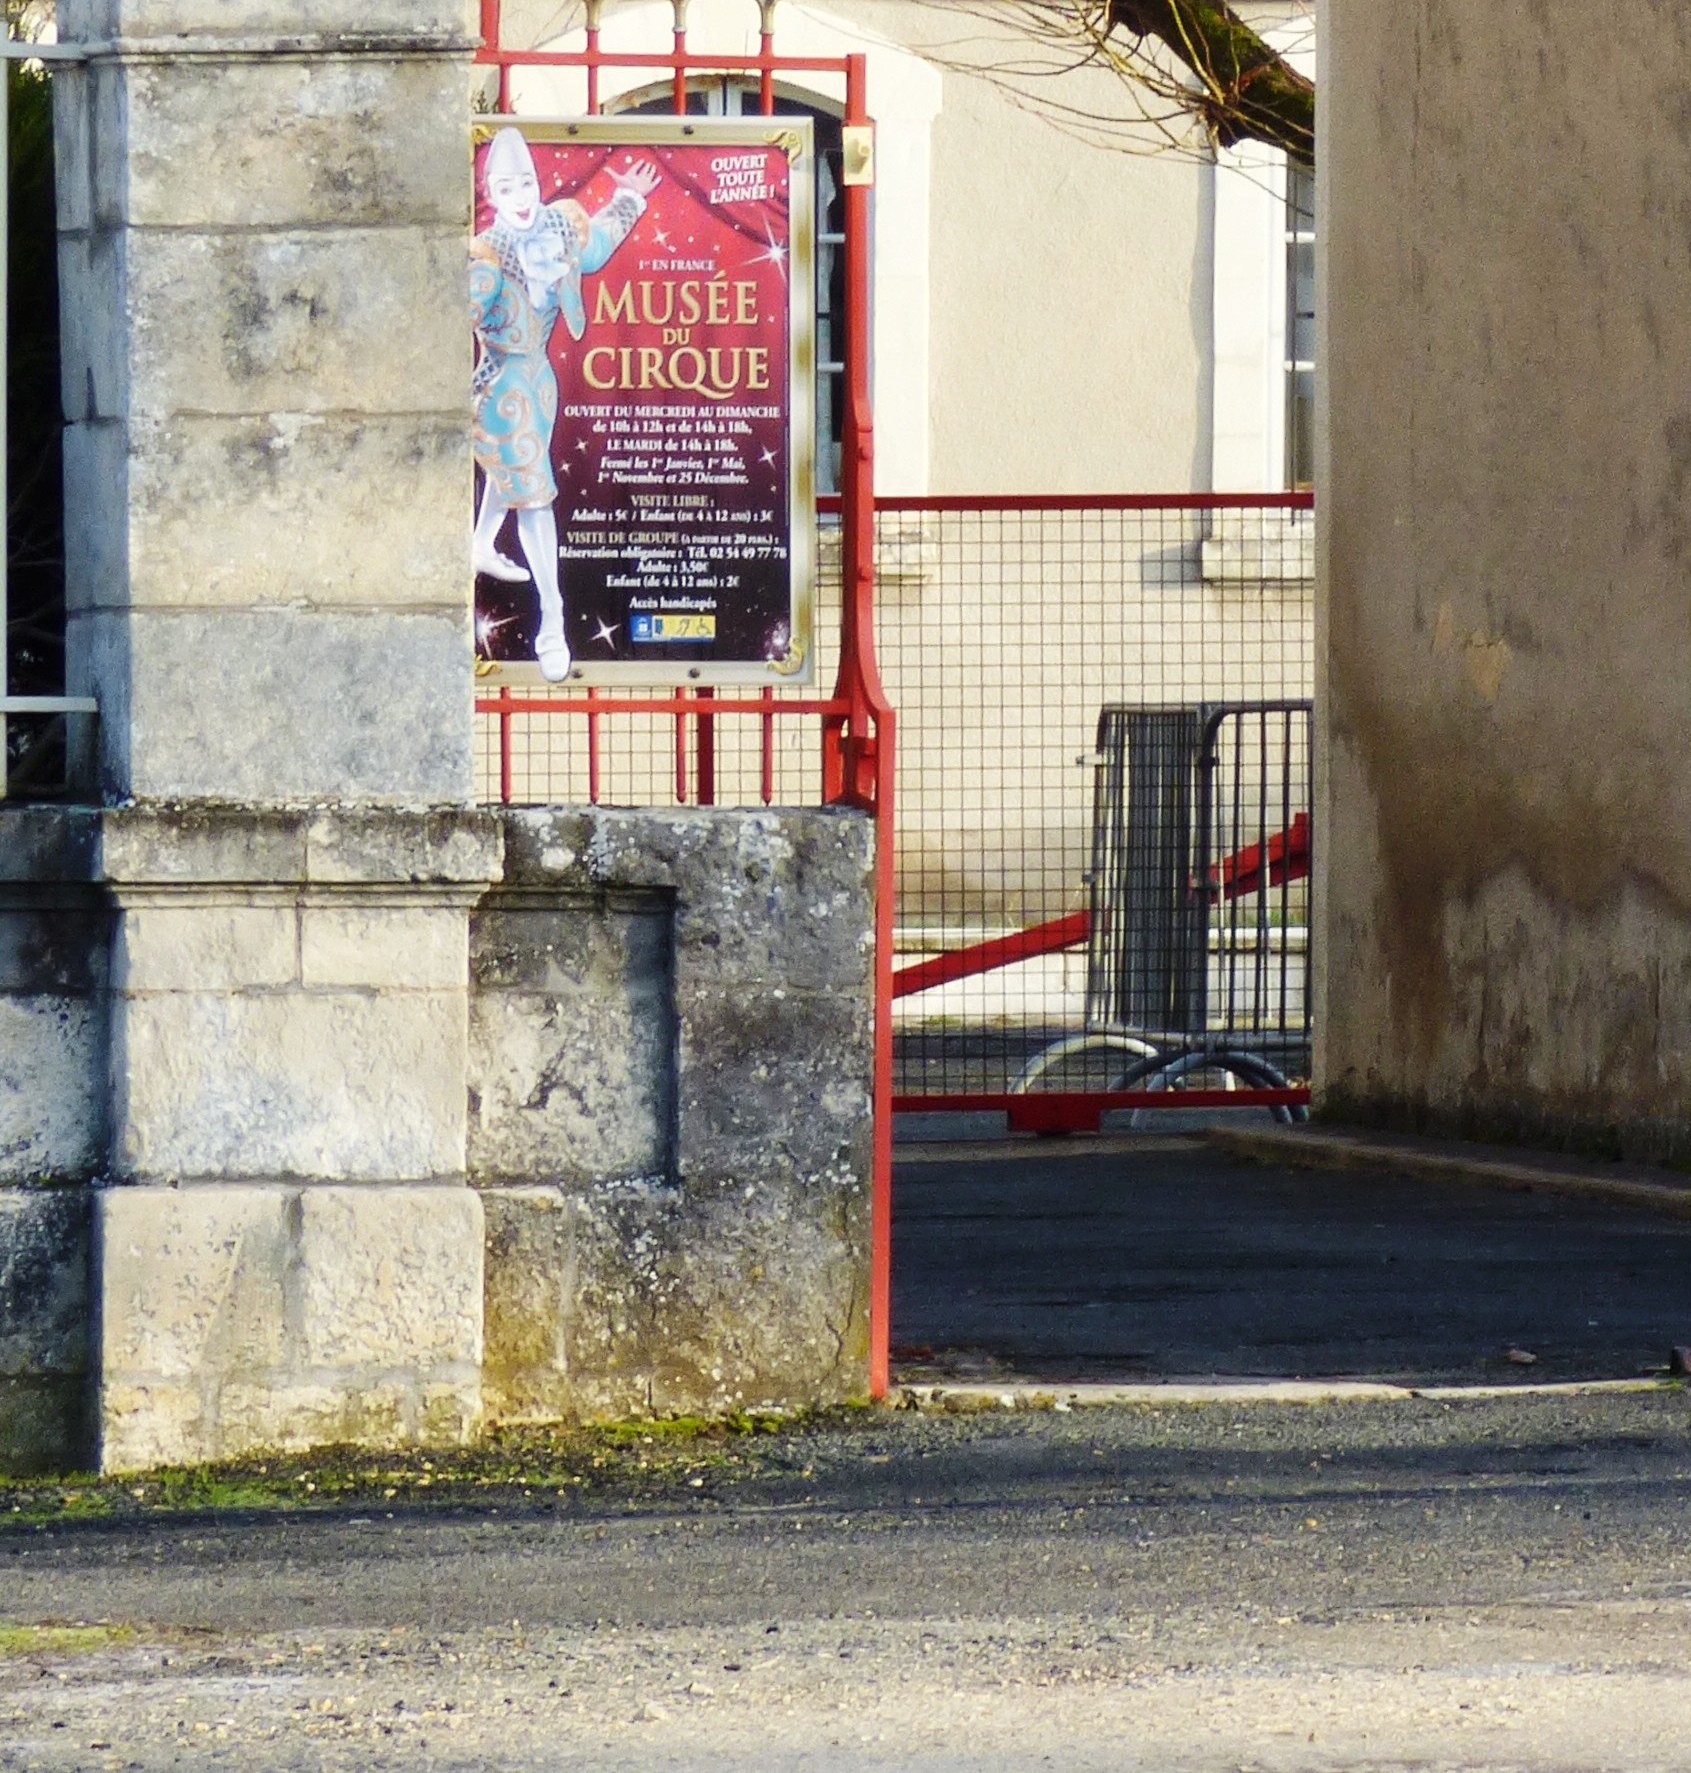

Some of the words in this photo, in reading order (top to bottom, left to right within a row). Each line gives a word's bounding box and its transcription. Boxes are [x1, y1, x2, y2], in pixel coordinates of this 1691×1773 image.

[711, 153, 768, 172] OUVERT
[717, 170, 764, 187] TOUTE
[652, 259, 669, 270] EN
[671, 259, 715, 271] FRANCE
[592, 270, 758, 325] MUSÉE
[662, 328, 690, 345] DU
[583, 347, 770, 400] CIRQUE
[564, 406, 612, 417] OUVERT
[614, 406, 633, 417] DU
[634, 406, 695, 417] MERCREDI
[698, 406, 714, 417] AU
[716, 406, 780, 417] DIMANCHE
[592, 419, 607, 433] de
[632, 419, 640, 433] à
[643, 419, 663, 433] 12h
[665, 419, 676, 433] et
[678, 419, 692, 433] de
[695, 419, 716, 433] 14h
[607, 438, 621, 451] LE
[623, 438, 662, 451] MARDI
[664, 438, 678, 451] de
[681, 438, 702, 451] 14h
[703, 438, 711, 451] à
[612, 471, 665, 484] Novembre
[666, 471, 677, 484] et
[678, 471, 693, 484] 25
[630, 494, 671, 506] VISITE
[672, 494, 709, 506] LIBRE
[571, 508, 607, 521] Adulte
[640, 508, 675, 521] Enfant
[715, 508, 728, 521] 12
[566, 531, 607, 544] VISITE
[608, 531, 627, 544] DE
[628, 531, 680, 544] GROUPE
[709, 546, 724, 558] 02
[757, 546, 771, 558] 77
[636, 560, 672, 573] Adulte
[606, 574, 641, 587] Enfant
[681, 574, 694, 587] 12
[629, 595, 658, 609] Accès
[660, 595, 717, 612] handicapés
